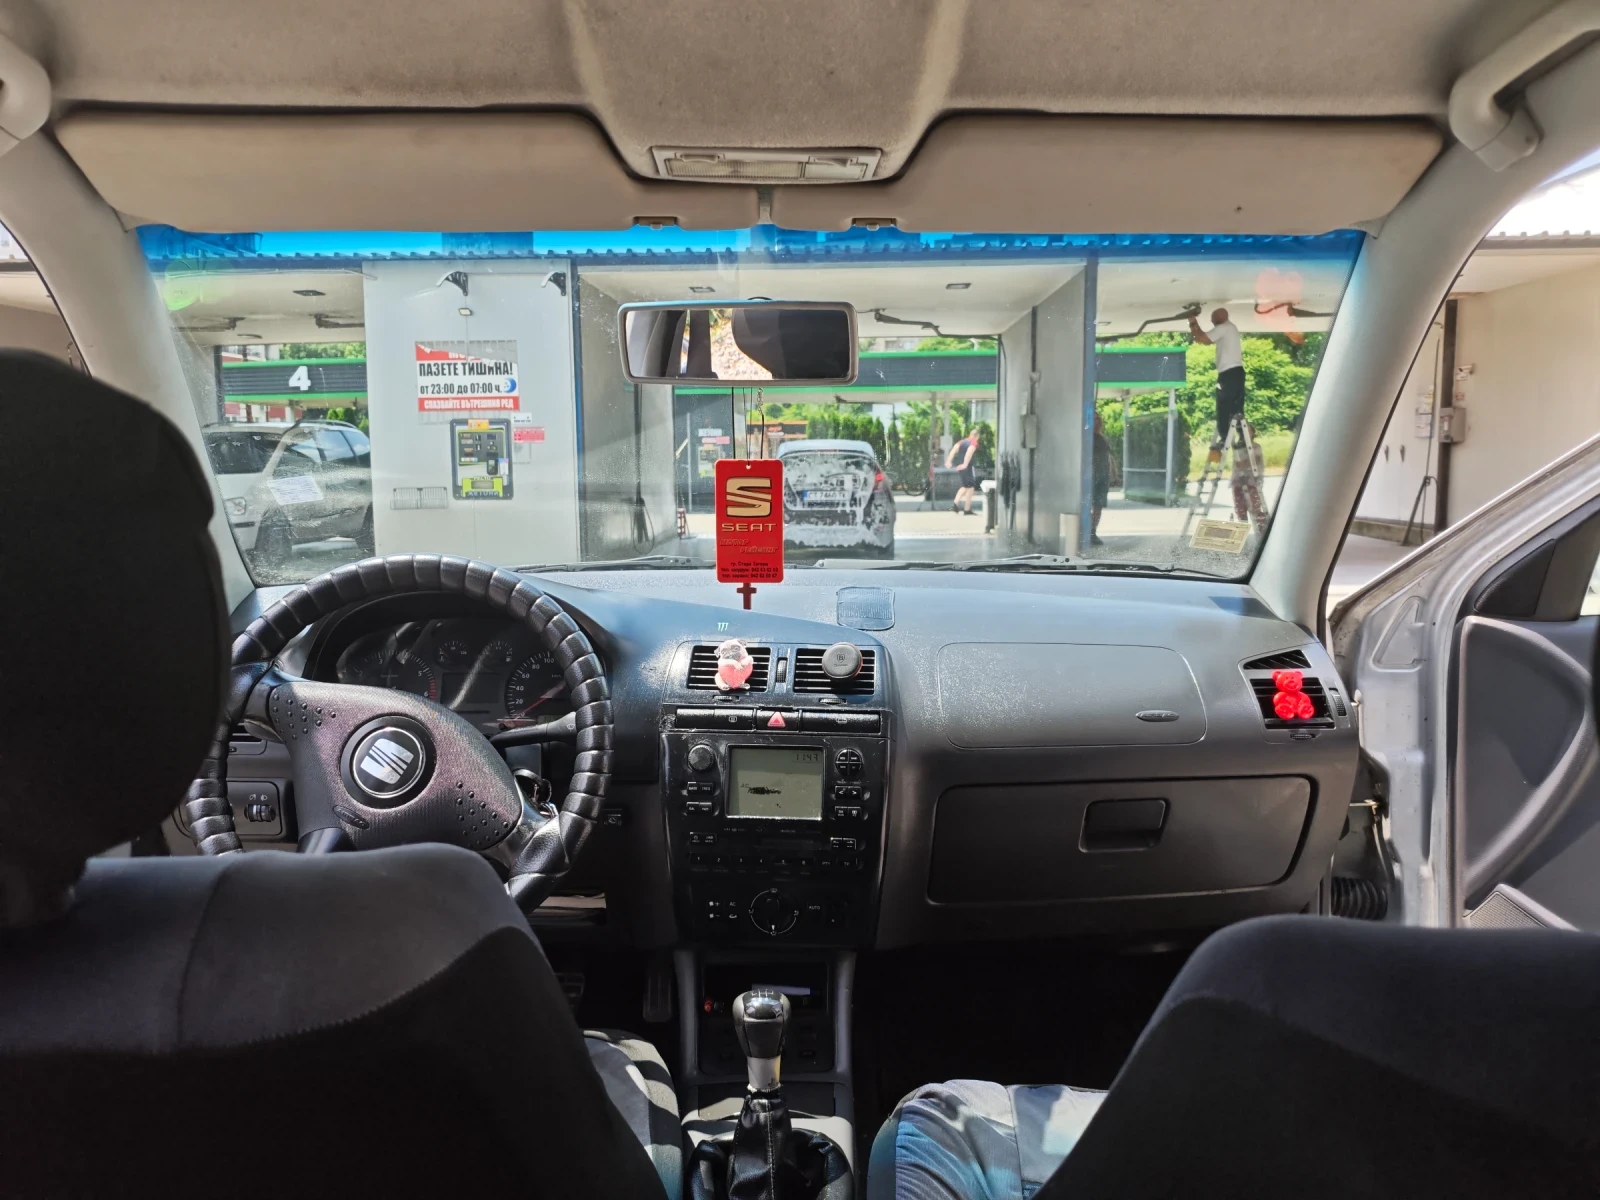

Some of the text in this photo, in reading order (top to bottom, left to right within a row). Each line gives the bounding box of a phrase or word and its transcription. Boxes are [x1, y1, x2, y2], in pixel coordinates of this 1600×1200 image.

[419, 362, 513, 377] ПАЗЕТЕ ТИШИНА!
[289, 366, 311, 390] 4
[420, 385, 429, 395] от
[431, 383, 455, 395] 23:00
[457, 385, 468, 395] до
[470, 382, 493, 394] 07:00
[501, 398, 514, 410] РЕД
[721, 523, 777, 532] SEAT
